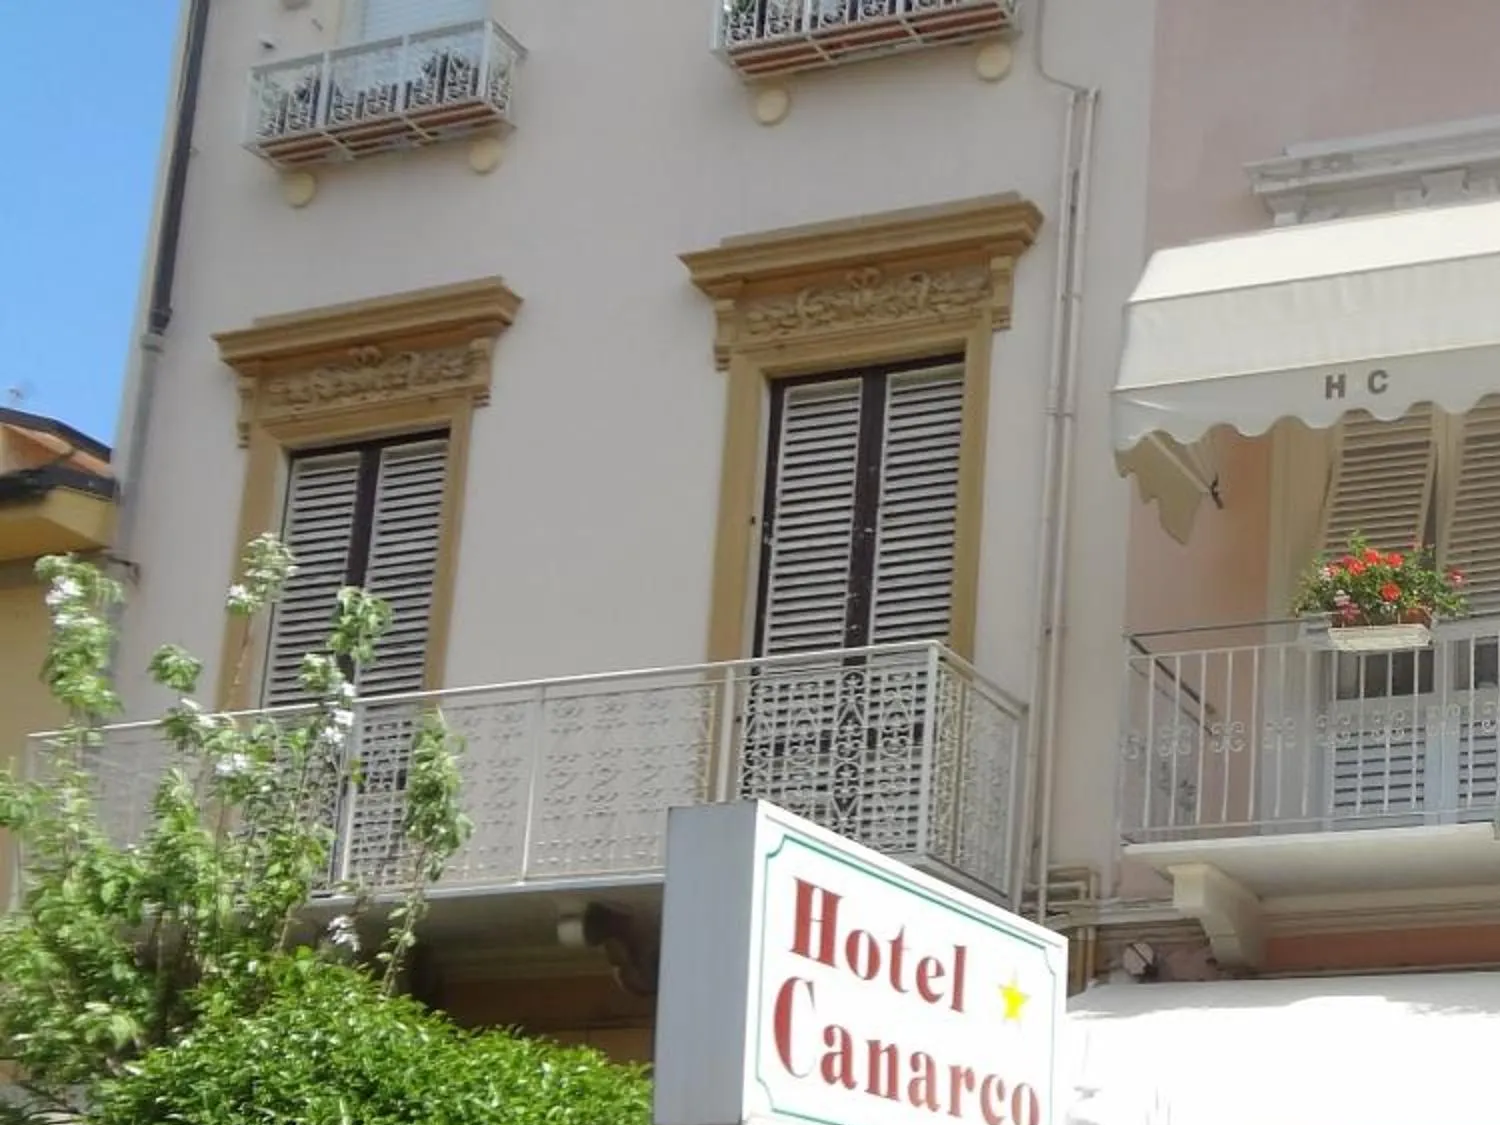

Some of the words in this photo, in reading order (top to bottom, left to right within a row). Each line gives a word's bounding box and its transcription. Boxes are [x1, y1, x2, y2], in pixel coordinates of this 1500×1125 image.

[1325, 373, 1346, 399] H
[1367, 369, 1388, 394] C
[790, 877, 967, 1013] Hotel
